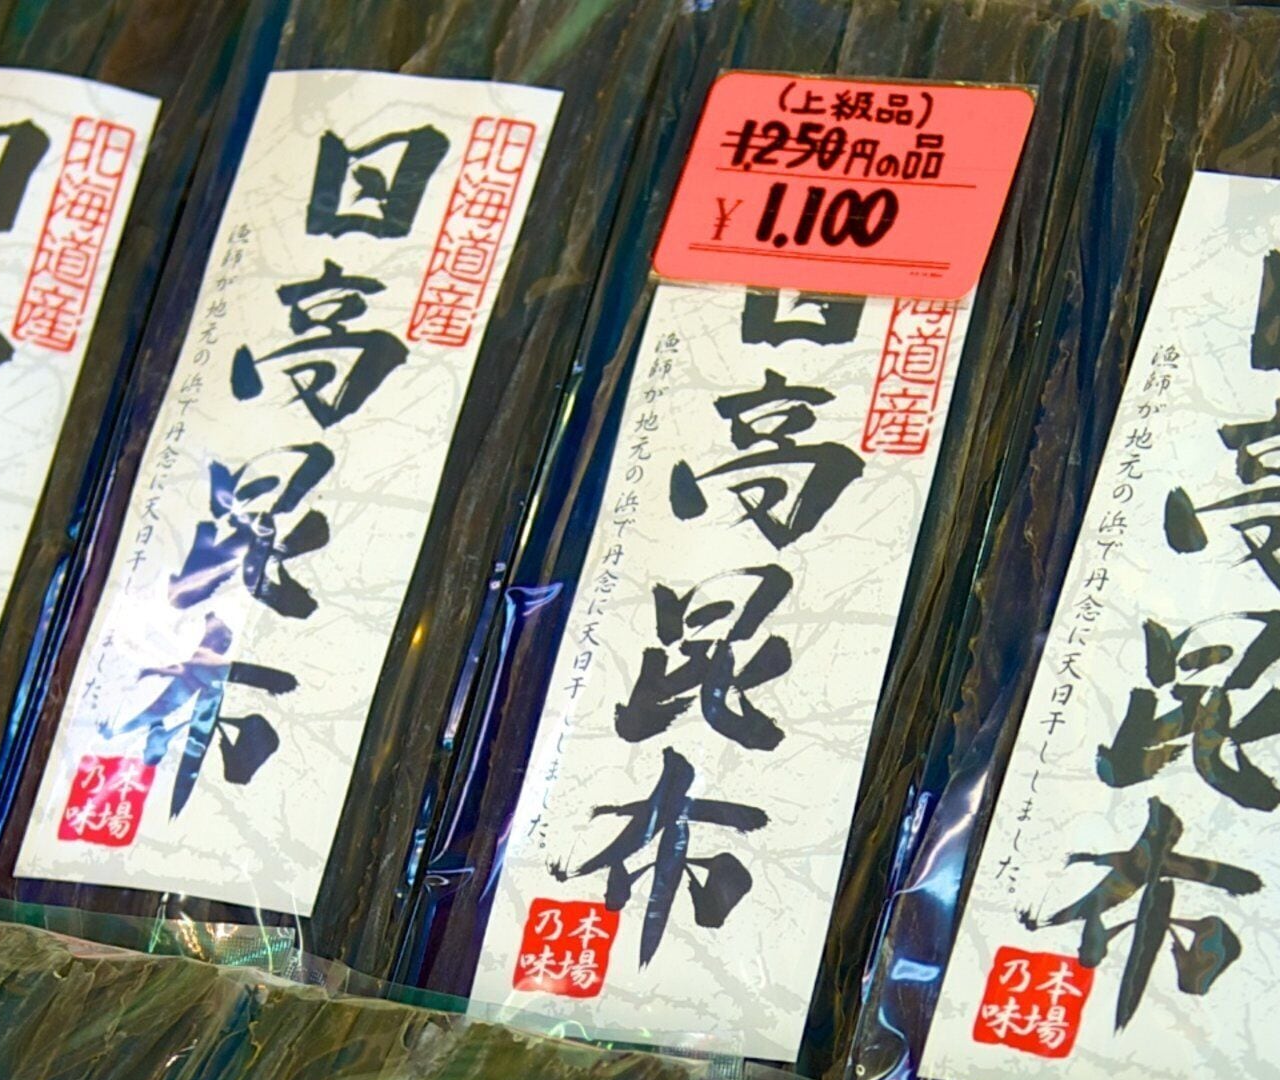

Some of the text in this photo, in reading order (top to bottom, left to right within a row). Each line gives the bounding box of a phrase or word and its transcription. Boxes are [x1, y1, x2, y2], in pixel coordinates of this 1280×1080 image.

[778, 81, 934, 129] (上級品)
[95, 124, 451, 822] 日高昆布
